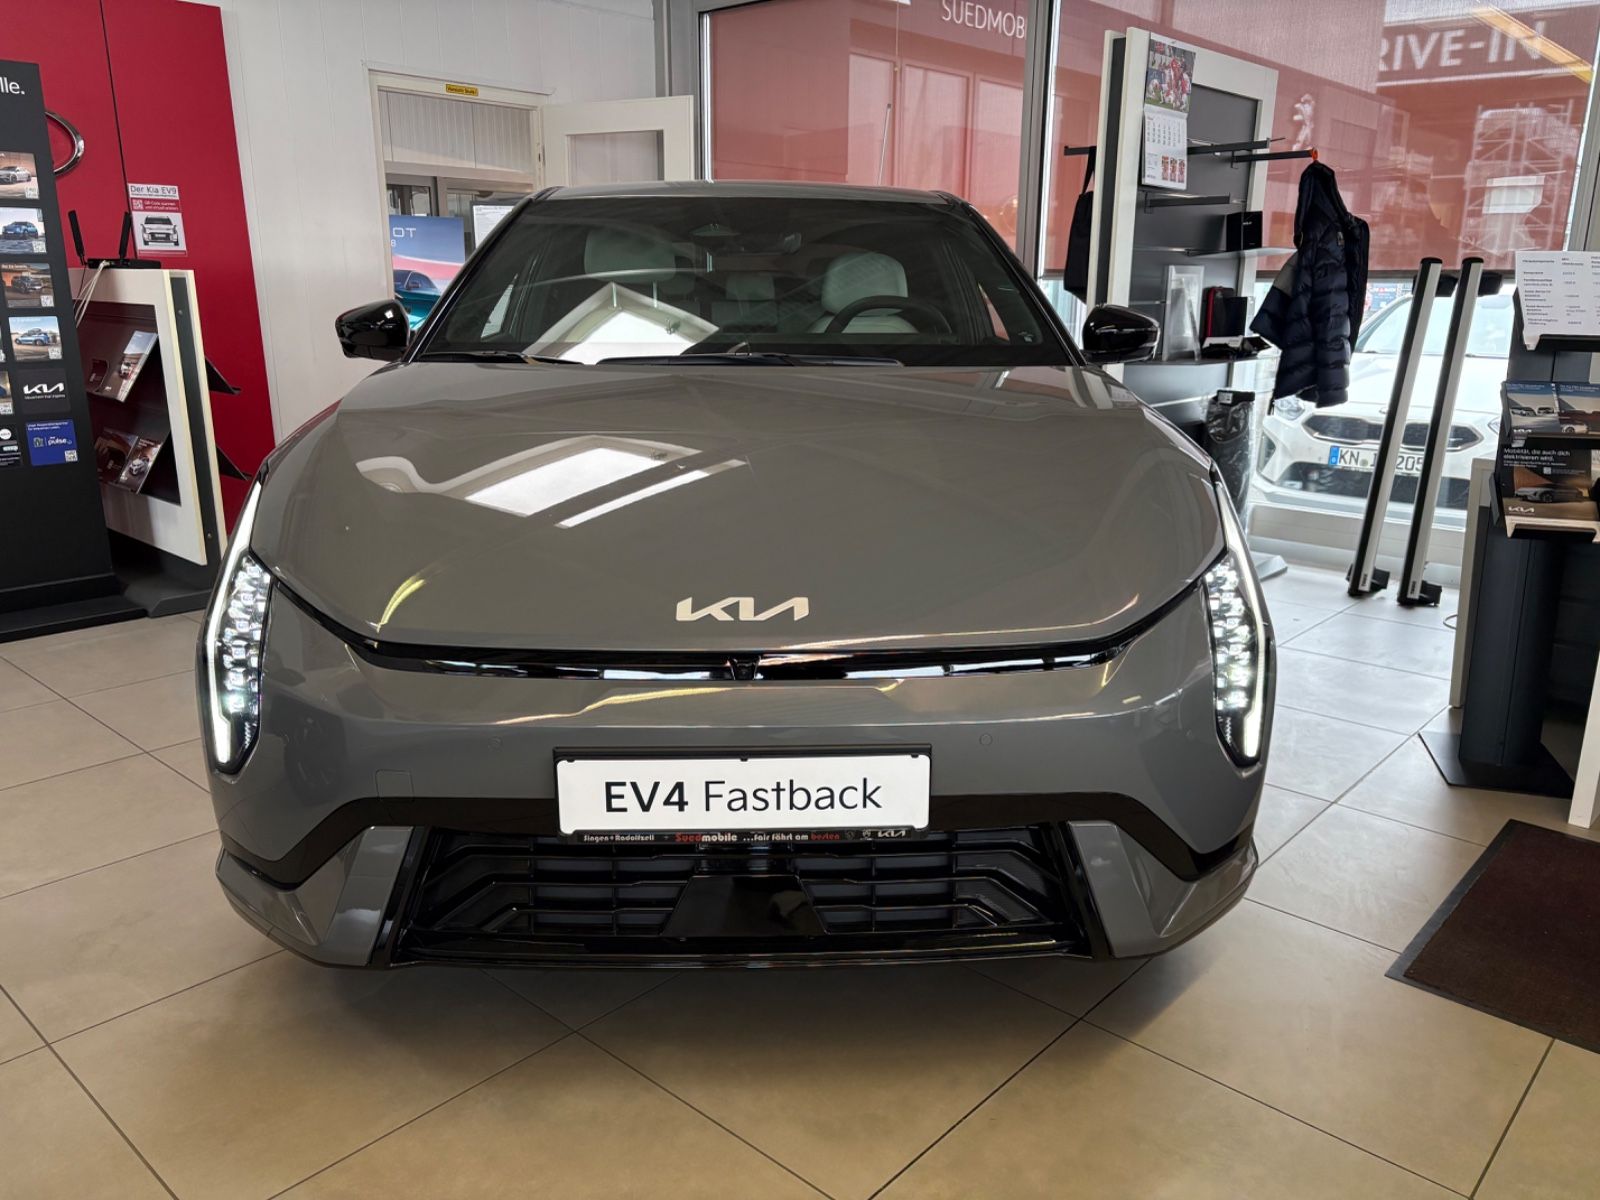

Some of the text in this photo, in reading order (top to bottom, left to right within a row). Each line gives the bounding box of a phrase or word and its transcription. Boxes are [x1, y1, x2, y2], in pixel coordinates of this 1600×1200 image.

[130, 185, 144, 193] Der
[161, 187, 177, 195] EV9
[23, 382, 65, 394] KIA
[1339, 449, 1360, 466] KN
[676, 596, 810, 622] KIA
[604, 778, 882, 813] EV4 Fastback
